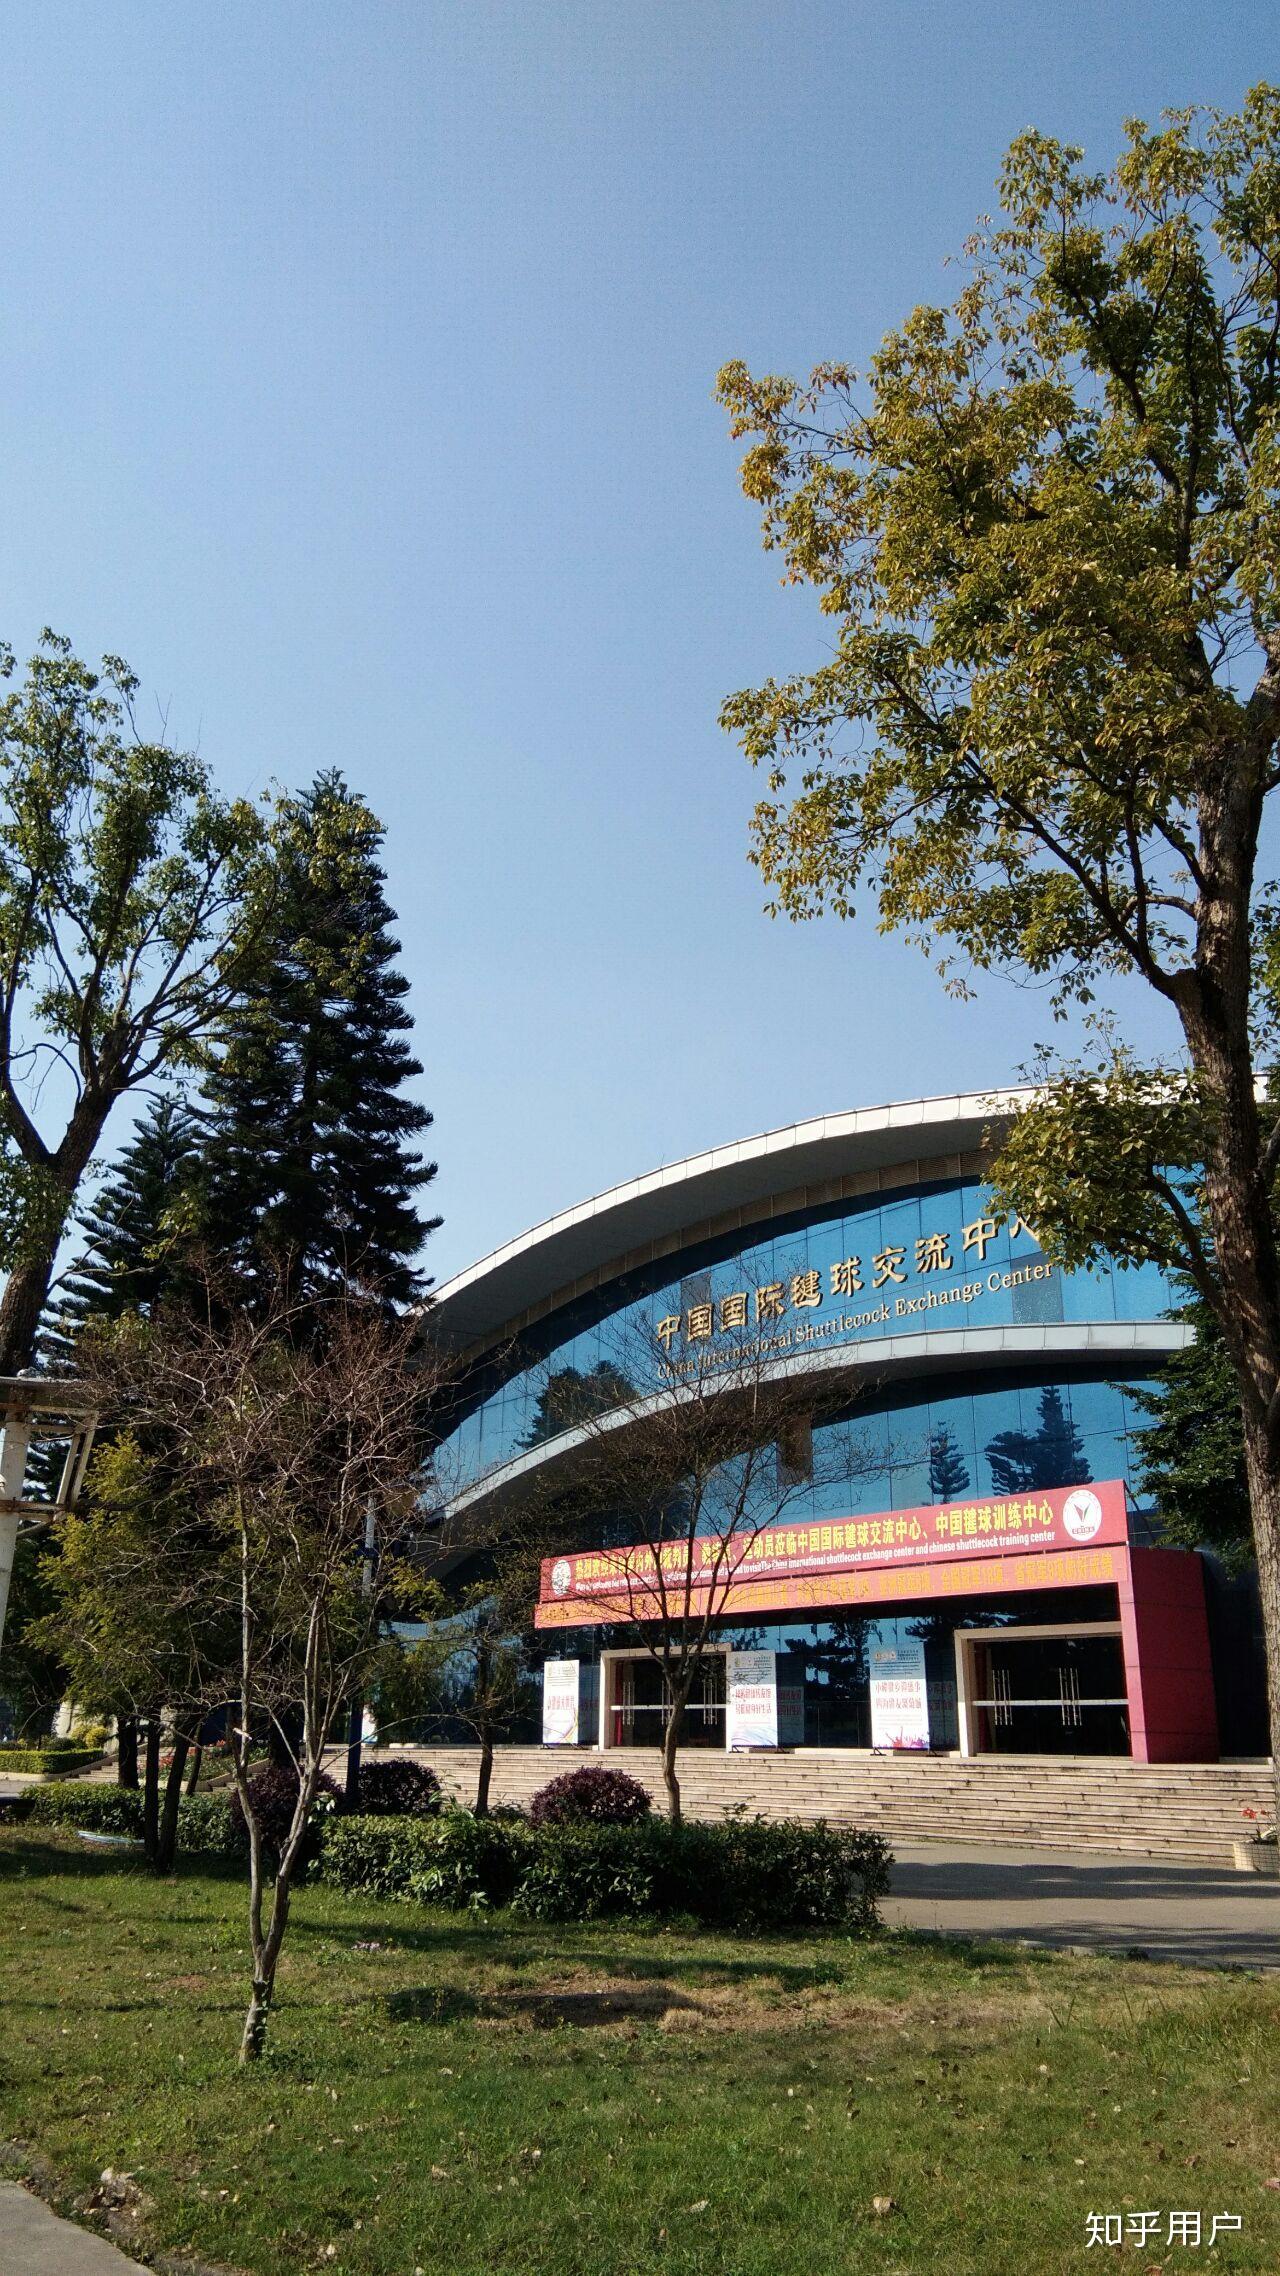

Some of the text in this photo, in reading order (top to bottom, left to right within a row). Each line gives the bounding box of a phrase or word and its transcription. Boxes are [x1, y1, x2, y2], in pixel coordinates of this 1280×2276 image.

[658, 1358, 694, 1379] China
[796, 1303, 891, 1342] Shuttlecock
[896, 1281, 983, 1317] Exchange
[988, 1262, 1053, 1291] Center
[826, 1550, 862, 1564] shuttlecock
[862, 1547, 893, 1561] exchange
[893, 1545, 914, 1557] center
[915, 1543, 928, 1555] and
[929, 1540, 955, 1554] chinese
[956, 1535, 998, 1551] shuttlecock
[999, 1531, 1029, 1547] training
[1030, 1530, 1056, 1543] center
